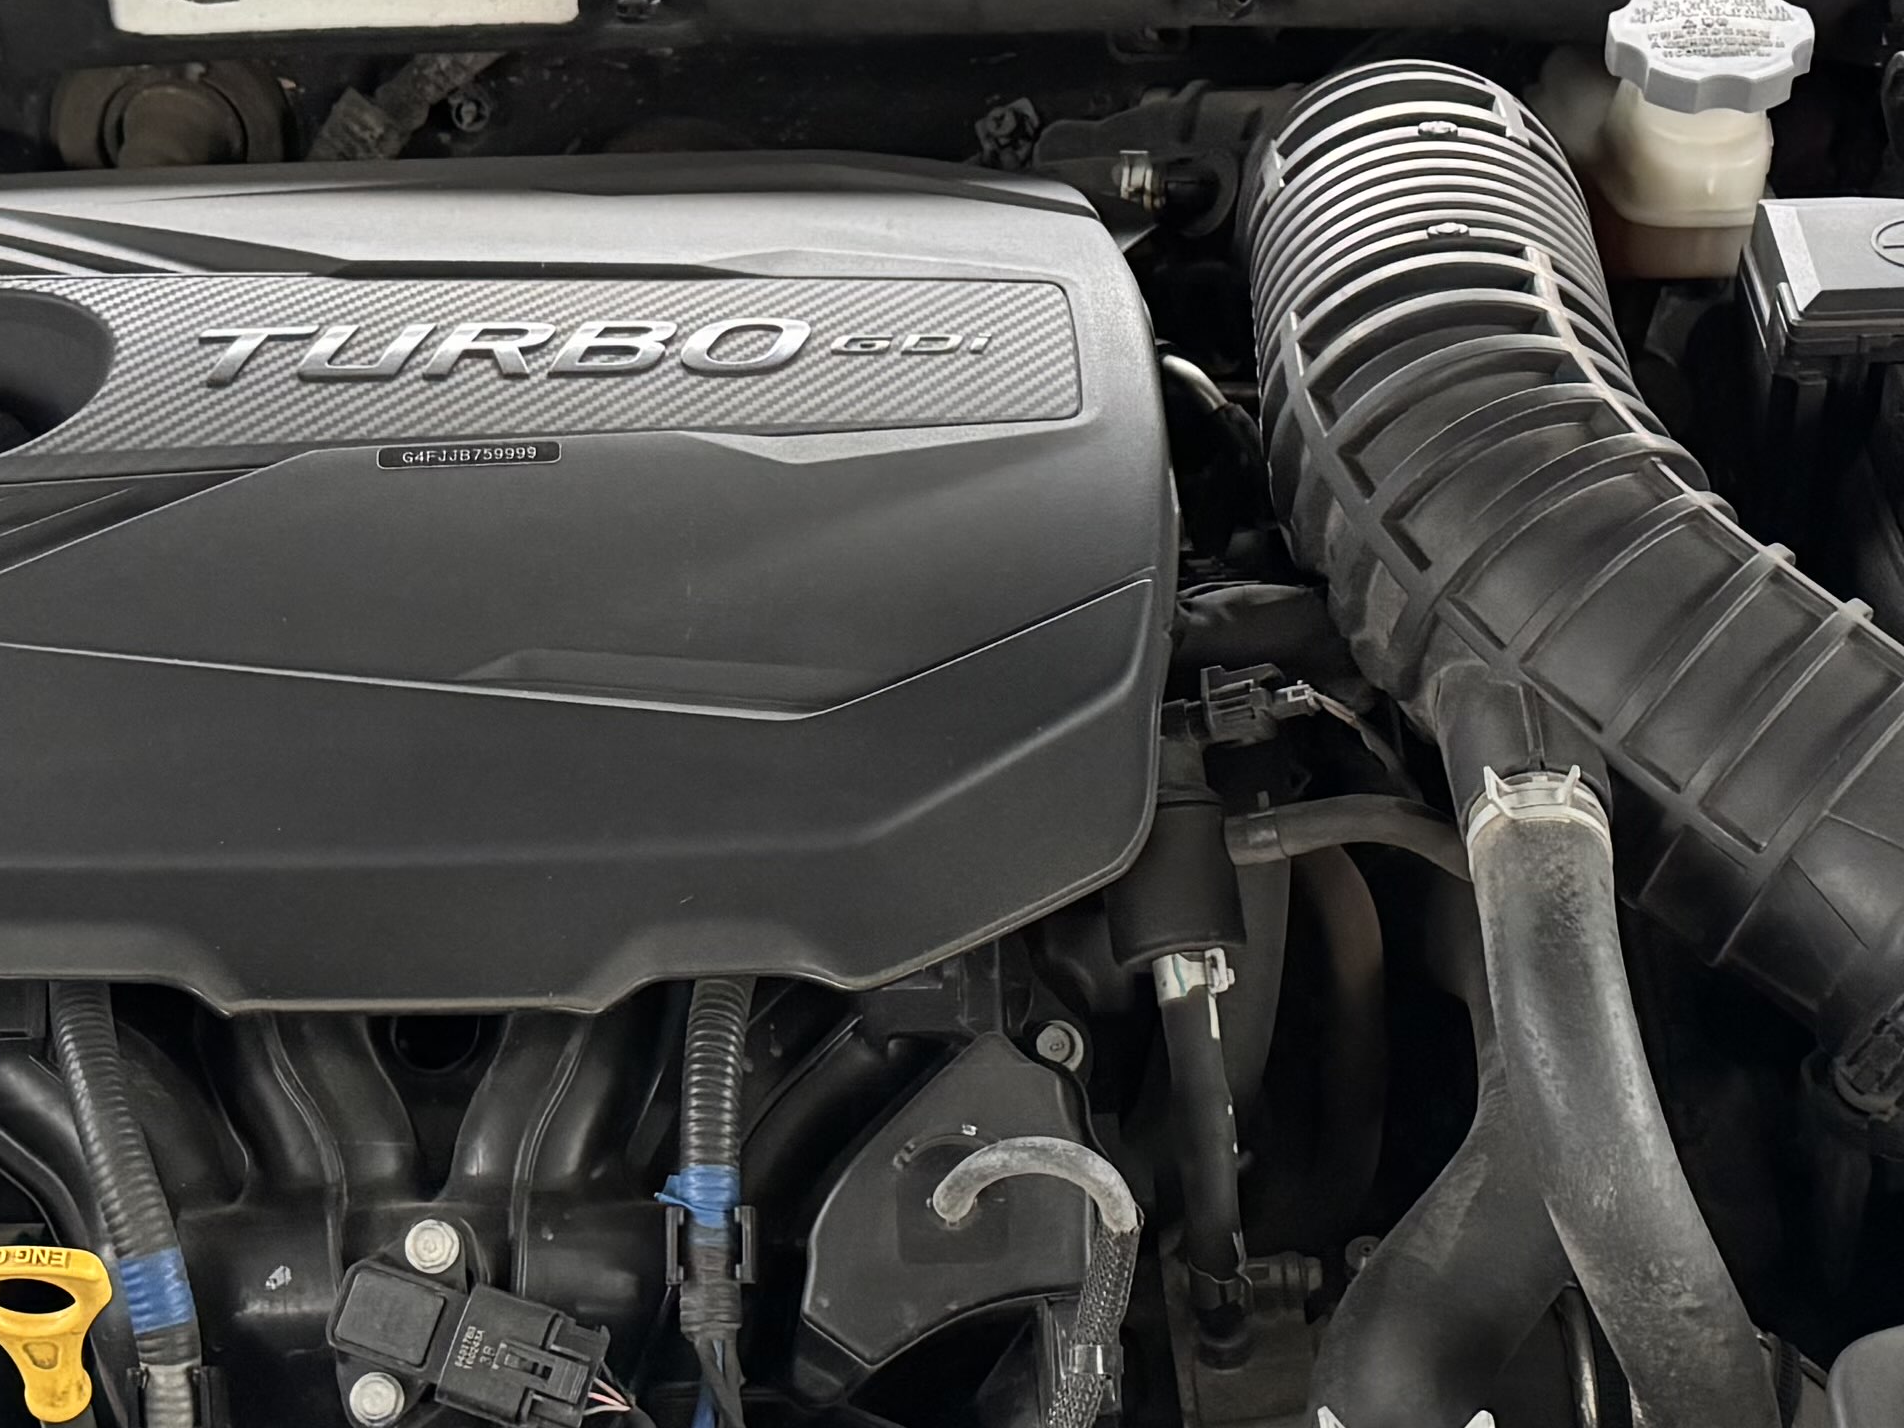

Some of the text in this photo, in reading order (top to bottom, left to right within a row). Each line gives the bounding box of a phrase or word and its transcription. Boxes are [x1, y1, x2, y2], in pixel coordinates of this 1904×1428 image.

[198, 317, 994, 387] TURBO GDi
[402, 445, 537, 464] G4FJJB759999
[14, 1248, 67, 1268] ENG
